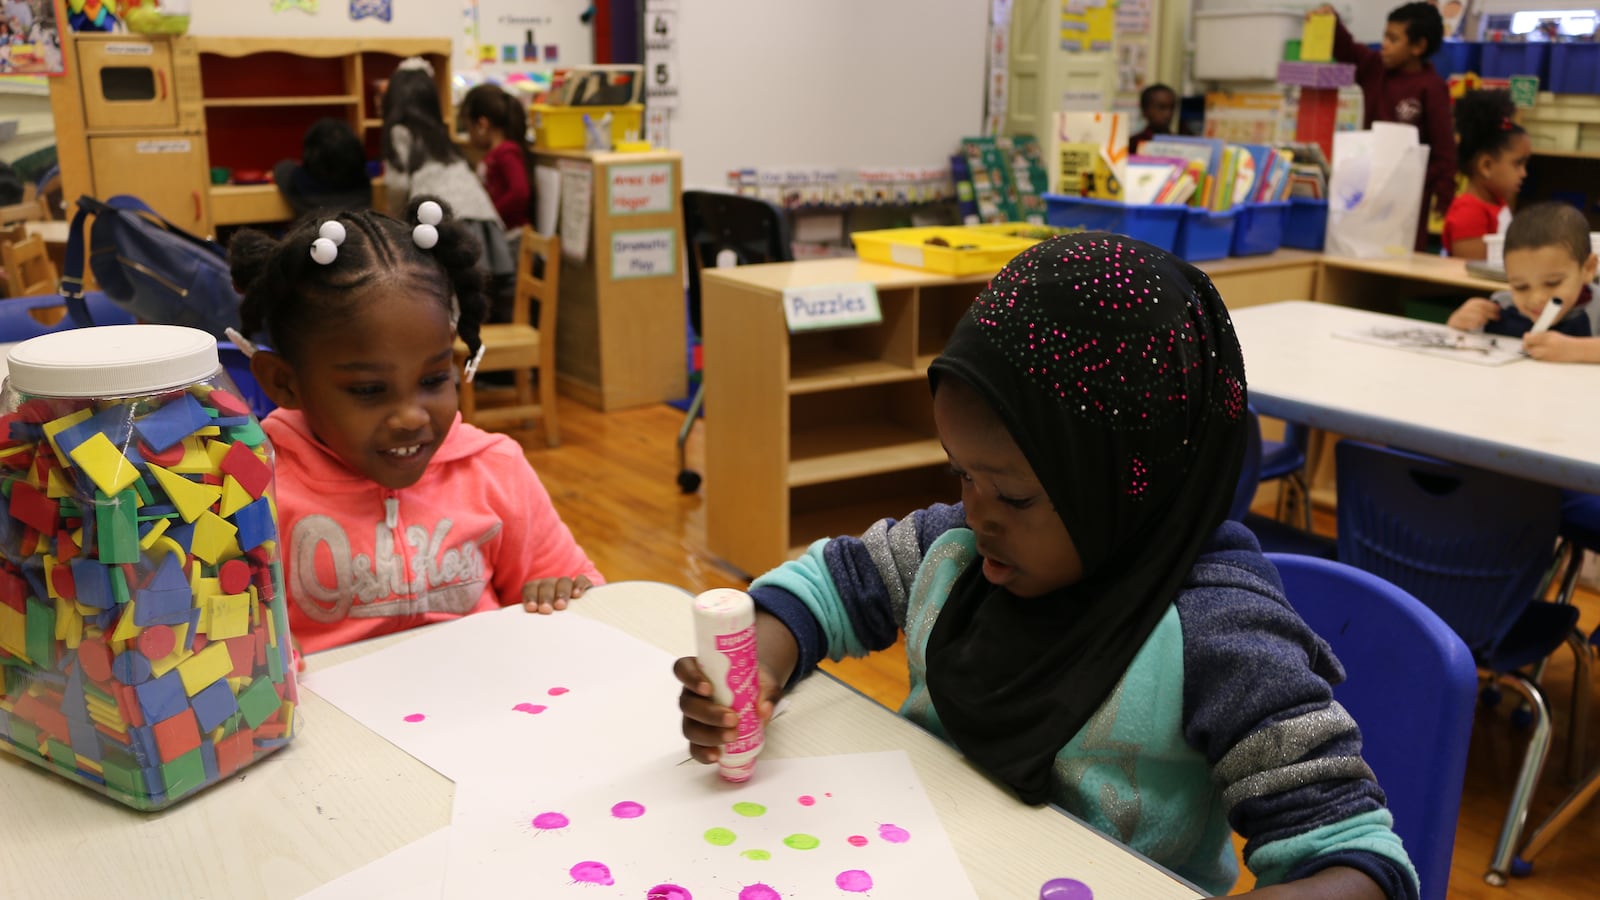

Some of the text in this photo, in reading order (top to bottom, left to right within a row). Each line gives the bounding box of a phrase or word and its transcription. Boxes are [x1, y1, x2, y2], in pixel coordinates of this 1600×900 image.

[654, 15, 668, 35] 4
[655, 64, 668, 84] 5
[613, 171, 667, 187] Area del
[612, 195, 650, 211] Hogar
[614, 238, 669, 254] Dramatic
[630, 257, 654, 273] Play
[792, 292, 866, 317] Puzzles
